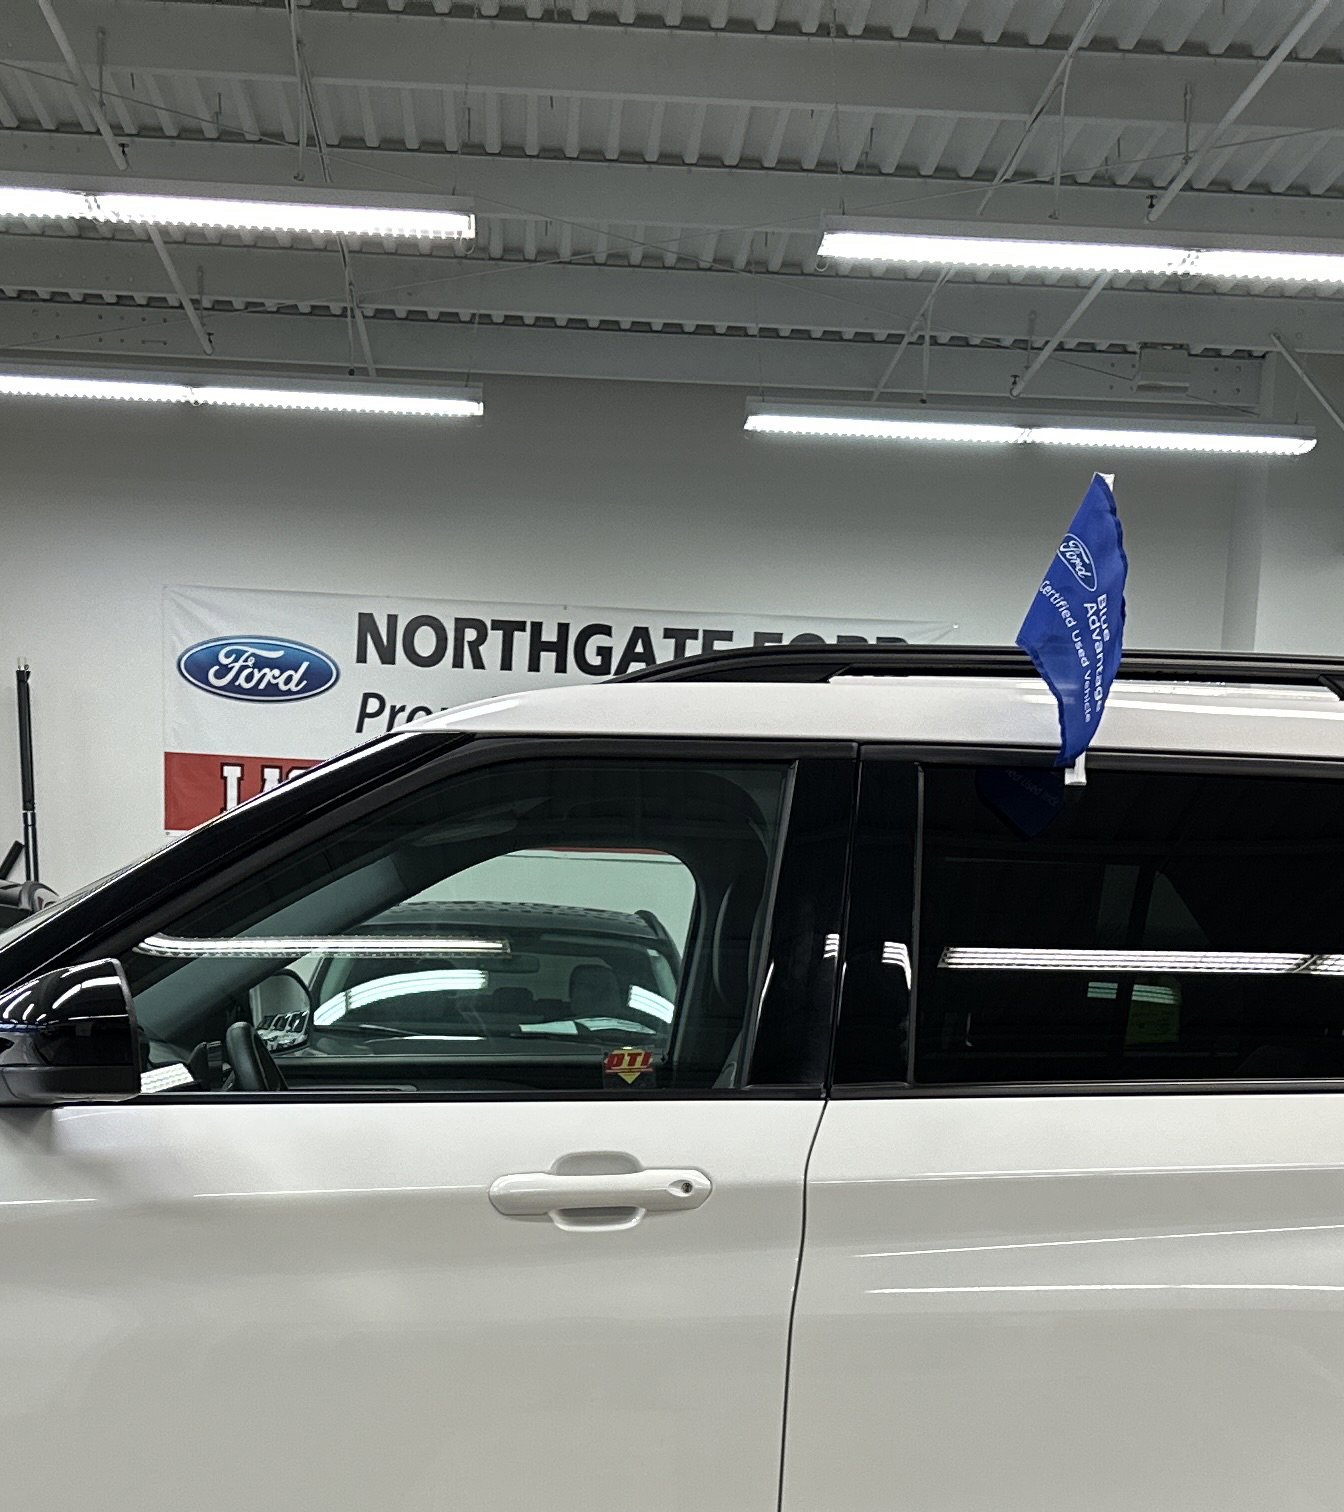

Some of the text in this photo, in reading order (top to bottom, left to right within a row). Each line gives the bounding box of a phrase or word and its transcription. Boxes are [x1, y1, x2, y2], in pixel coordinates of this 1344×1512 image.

[1060, 539, 1092, 580] Ford
[1096, 593, 1111, 643] Blue
[208, 645, 309, 692] Ford
[1039, 579, 1093, 724] Certified Used Vehicle
[1083, 602, 1104, 713] Advantage
